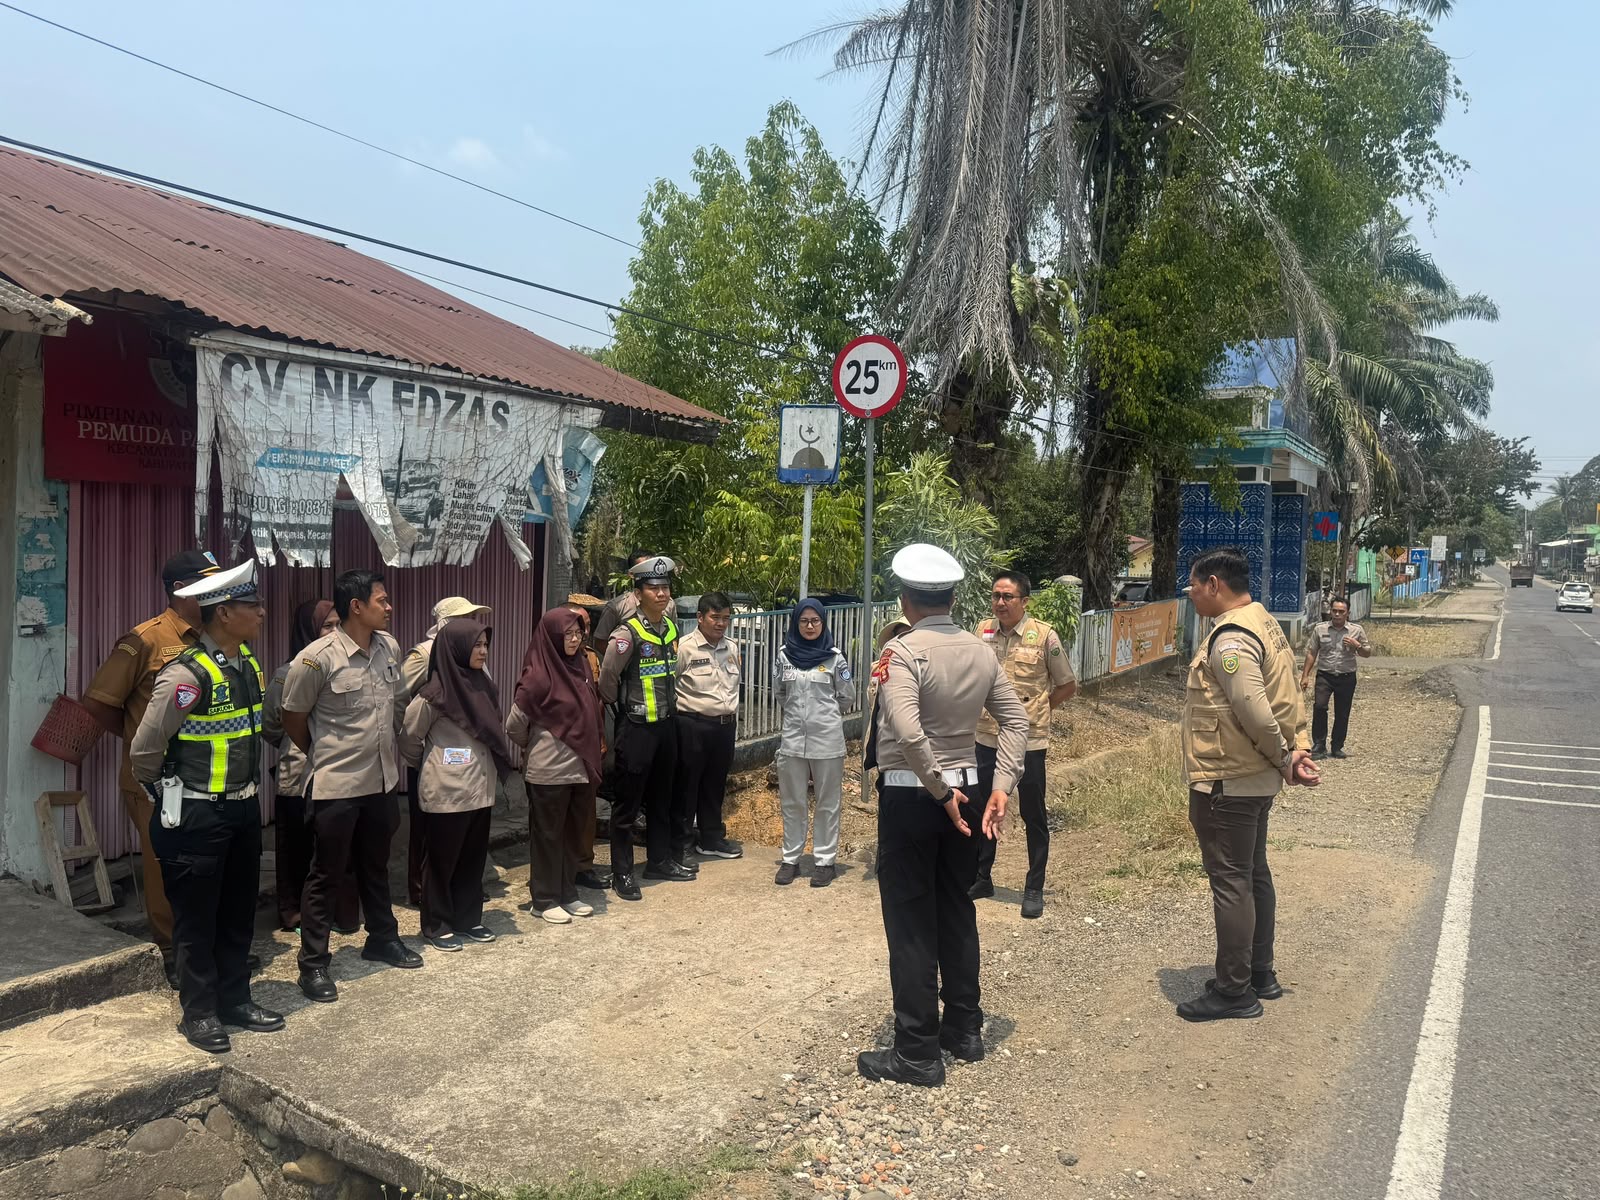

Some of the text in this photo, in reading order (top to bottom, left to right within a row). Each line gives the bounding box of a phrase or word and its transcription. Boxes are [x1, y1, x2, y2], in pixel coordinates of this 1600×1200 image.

[313, 366, 378, 412] NK
[845, 359, 897, 395] 25 km
[63, 402, 163, 426] PIMPINAN
[76, 420, 175, 446] PEMUDA
[476, 503, 496, 513] Enim
